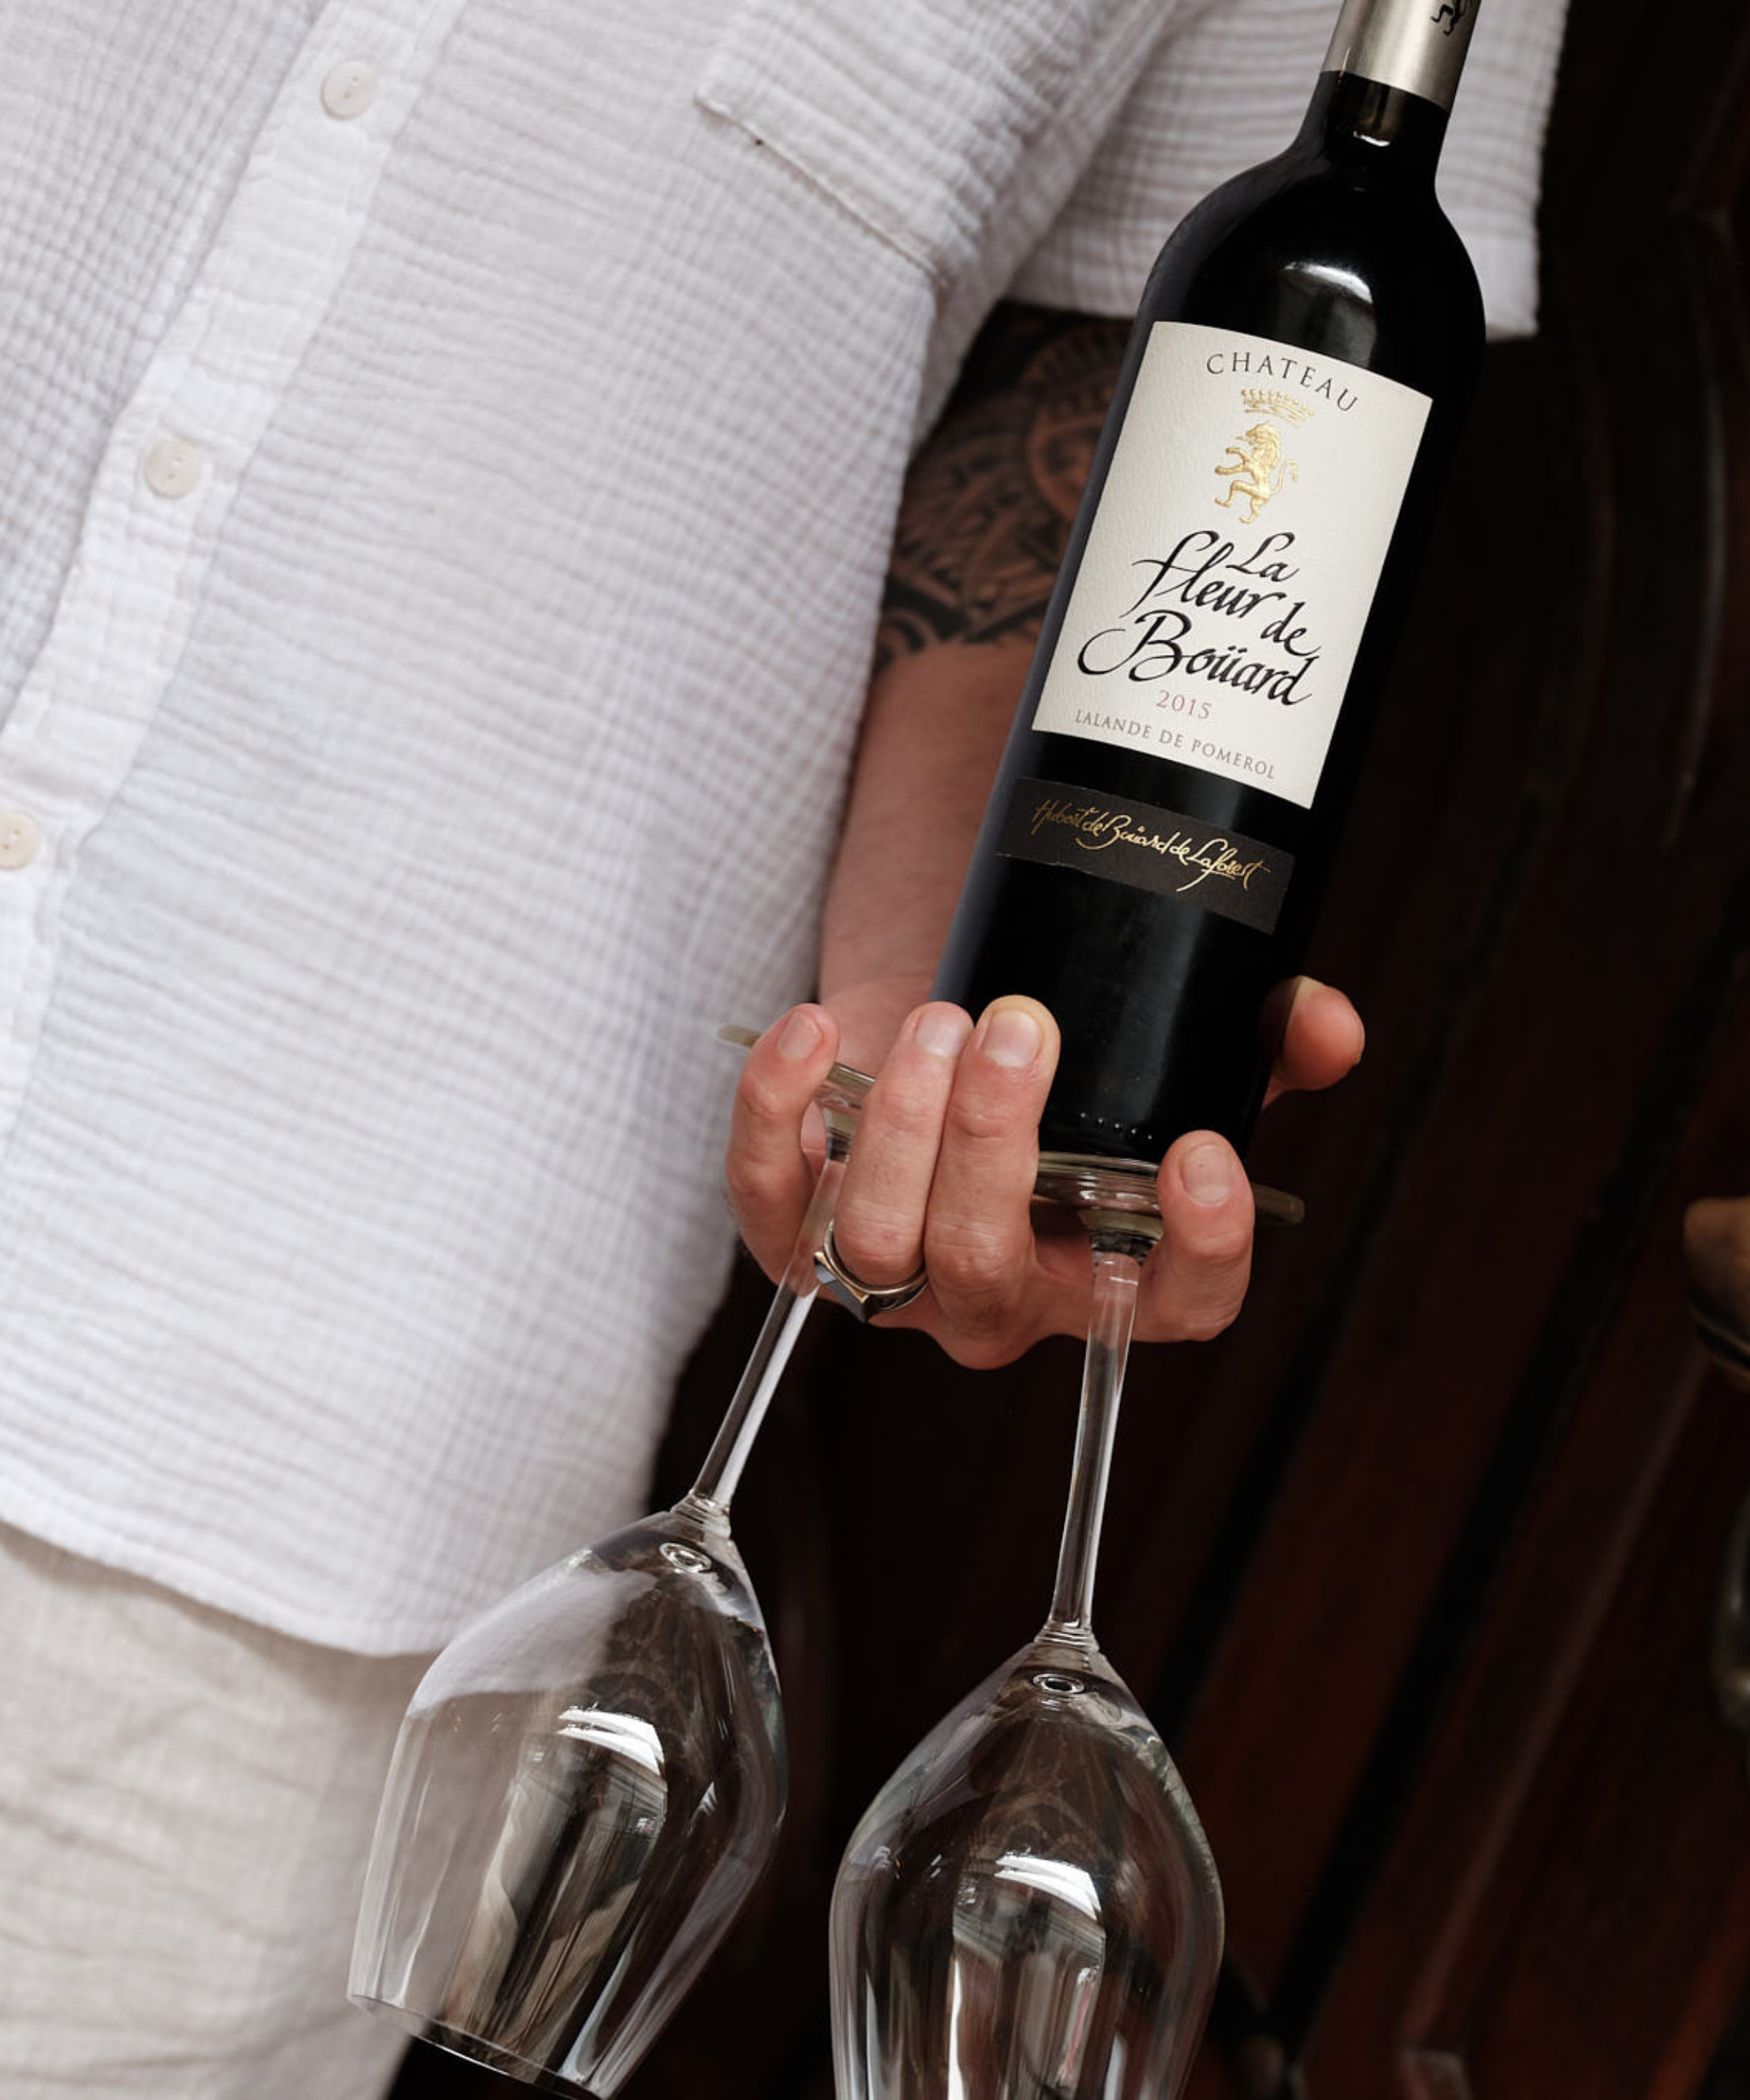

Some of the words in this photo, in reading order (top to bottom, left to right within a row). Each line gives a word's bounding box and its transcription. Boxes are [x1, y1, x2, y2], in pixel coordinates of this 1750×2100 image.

[1206, 352, 1359, 411] CHATEAU
[1225, 531, 1300, 582] La
[1260, 601, 1322, 657] de
[1156, 689, 1213, 719] 2015
[1075, 710, 1152, 739] LALANDE
[1159, 729, 1183, 748] DE
[1191, 739, 1275, 779] POMEROL
[1169, 838, 1192, 866] de
